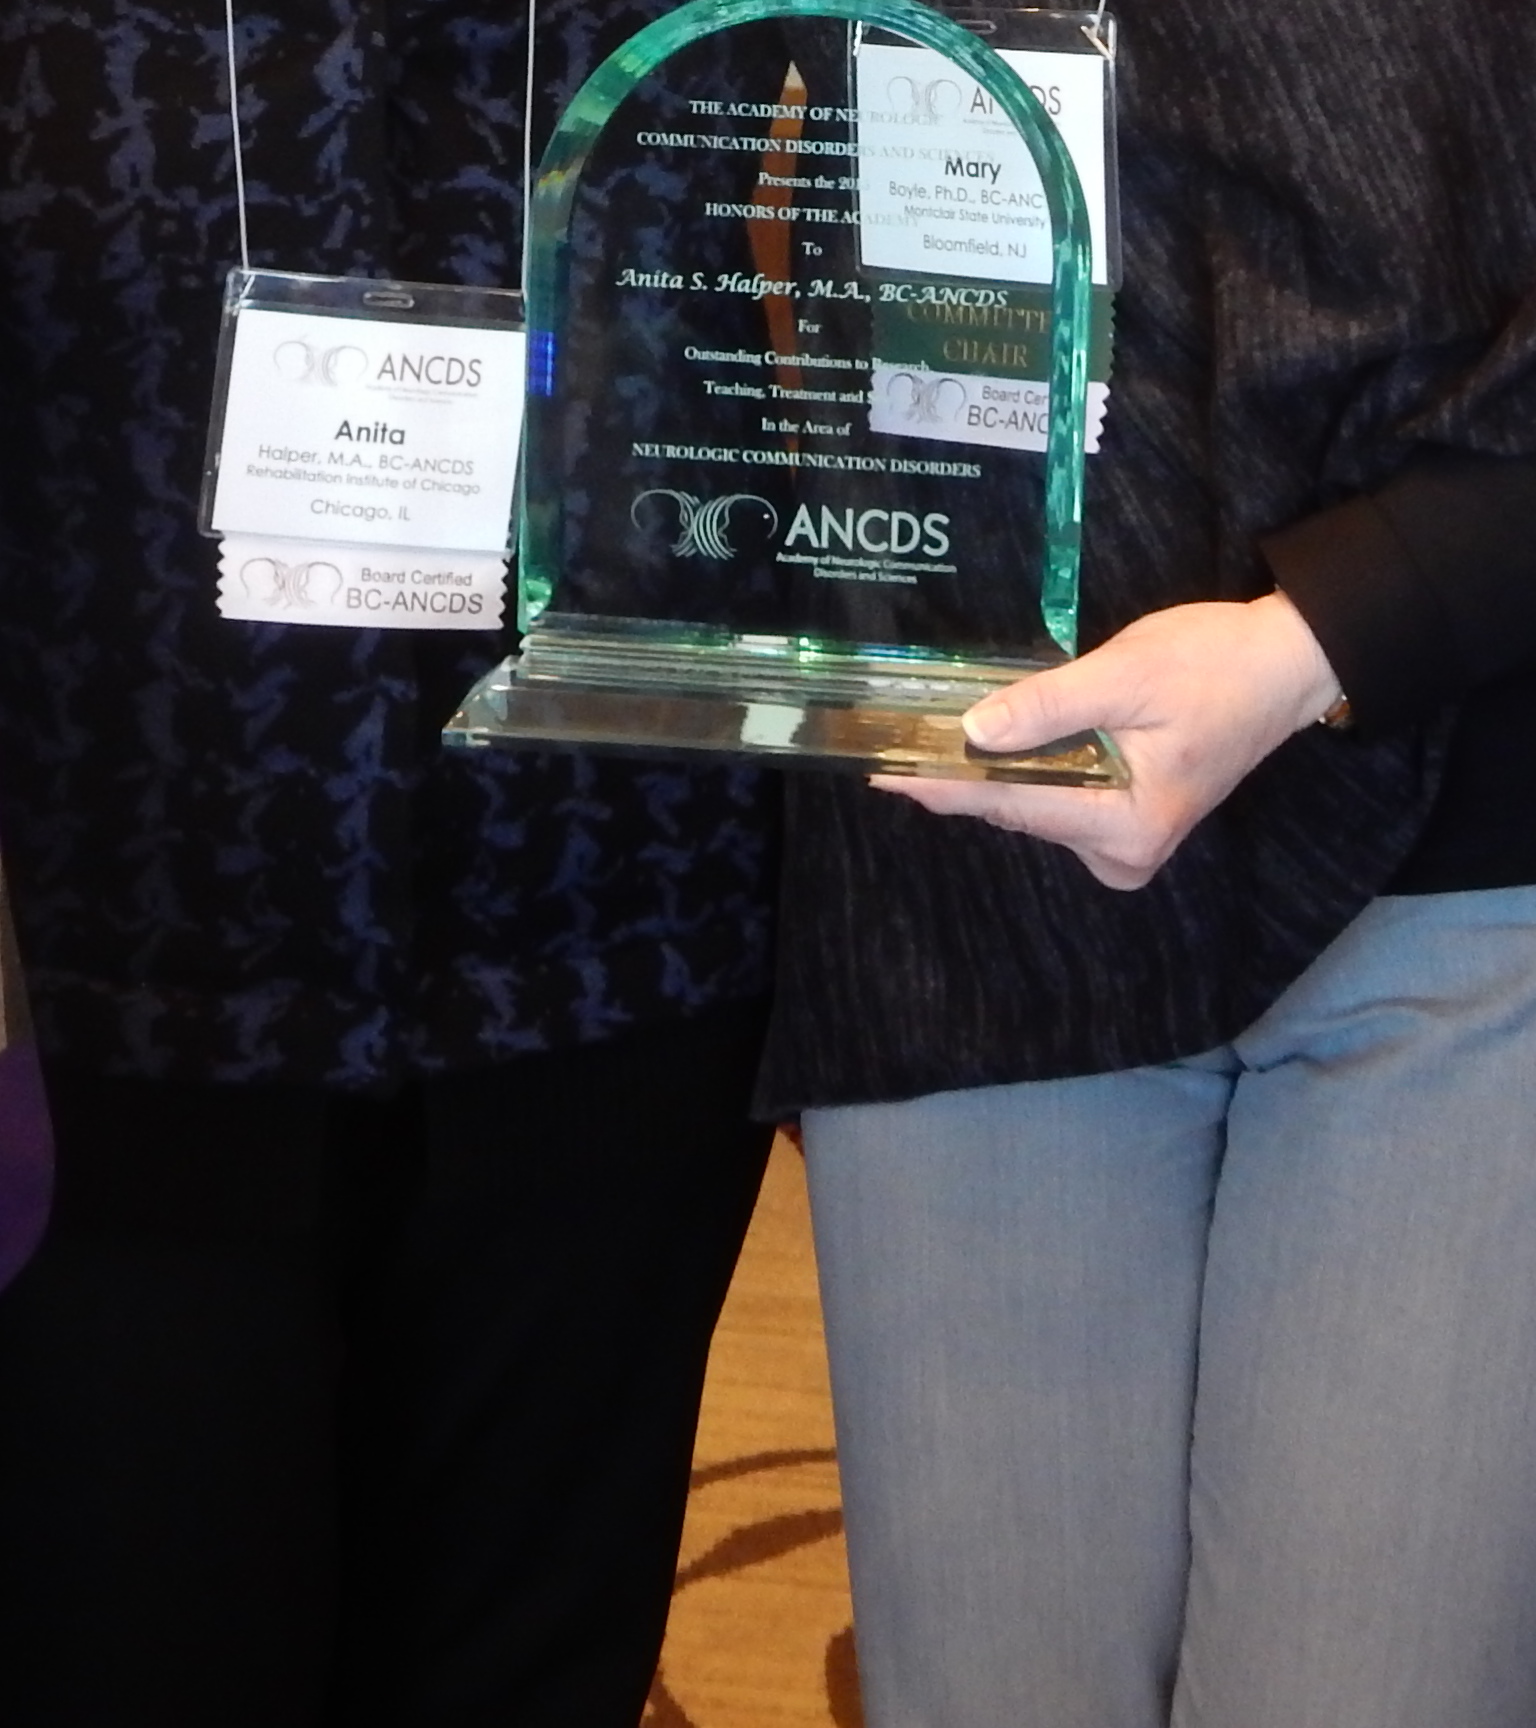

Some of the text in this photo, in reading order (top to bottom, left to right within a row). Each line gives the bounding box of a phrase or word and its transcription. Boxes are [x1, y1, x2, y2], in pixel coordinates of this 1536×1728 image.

[688, 99, 723, 116] THE
[726, 101, 808, 120] ACADEMY
[809, 106, 833, 121] OF
[636, 131, 781, 153] COMMUNICATION
[758, 172, 813, 189] Presents
[814, 174, 836, 189] the
[944, 156, 1002, 185] Mary
[889, 180, 931, 201] Boyle,
[980, 189, 1044, 210] BC-ANC
[704, 202, 775, 220] HONORS
[777, 206, 801, 221] OF
[802, 208, 839, 223] THE
[904, 204, 1047, 231] Montclair State University
[802, 241, 823, 256] To
[923, 234, 1027, 259] Bloomfield, NJ
[615, 268, 1010, 308] Anita S. Halper, M.A., BC-ANCDS
[798, 319, 823, 334] For
[376, 352, 483, 388] ANCDS
[684, 346, 762, 367] Outstanding
[764, 350, 853, 370] Contributions
[854, 358, 870, 370] to
[703, 380, 766, 399] Teaching,
[768, 384, 837, 402] Treatment
[838, 389, 864, 404] and
[982, 385, 1021, 404] Board
[334, 419, 406, 445] Anita
[761, 416, 853, 436] In the Area of
[967, 404, 1049, 435] BC-ANC
[258, 444, 322, 466] Halper,
[378, 453, 475, 476] BC-ANCDS
[632, 442, 982, 478] NEUROLOGIC COMMUNICATION DISORDERS
[246, 463, 481, 497] Rehabilitation Institute of Chicago
[310, 498, 411, 522] Chicago, IL
[784, 502, 951, 557] ANCDS
[361, 567, 473, 588] Board Certified
[346, 587, 484, 615] BC-ANCDS
